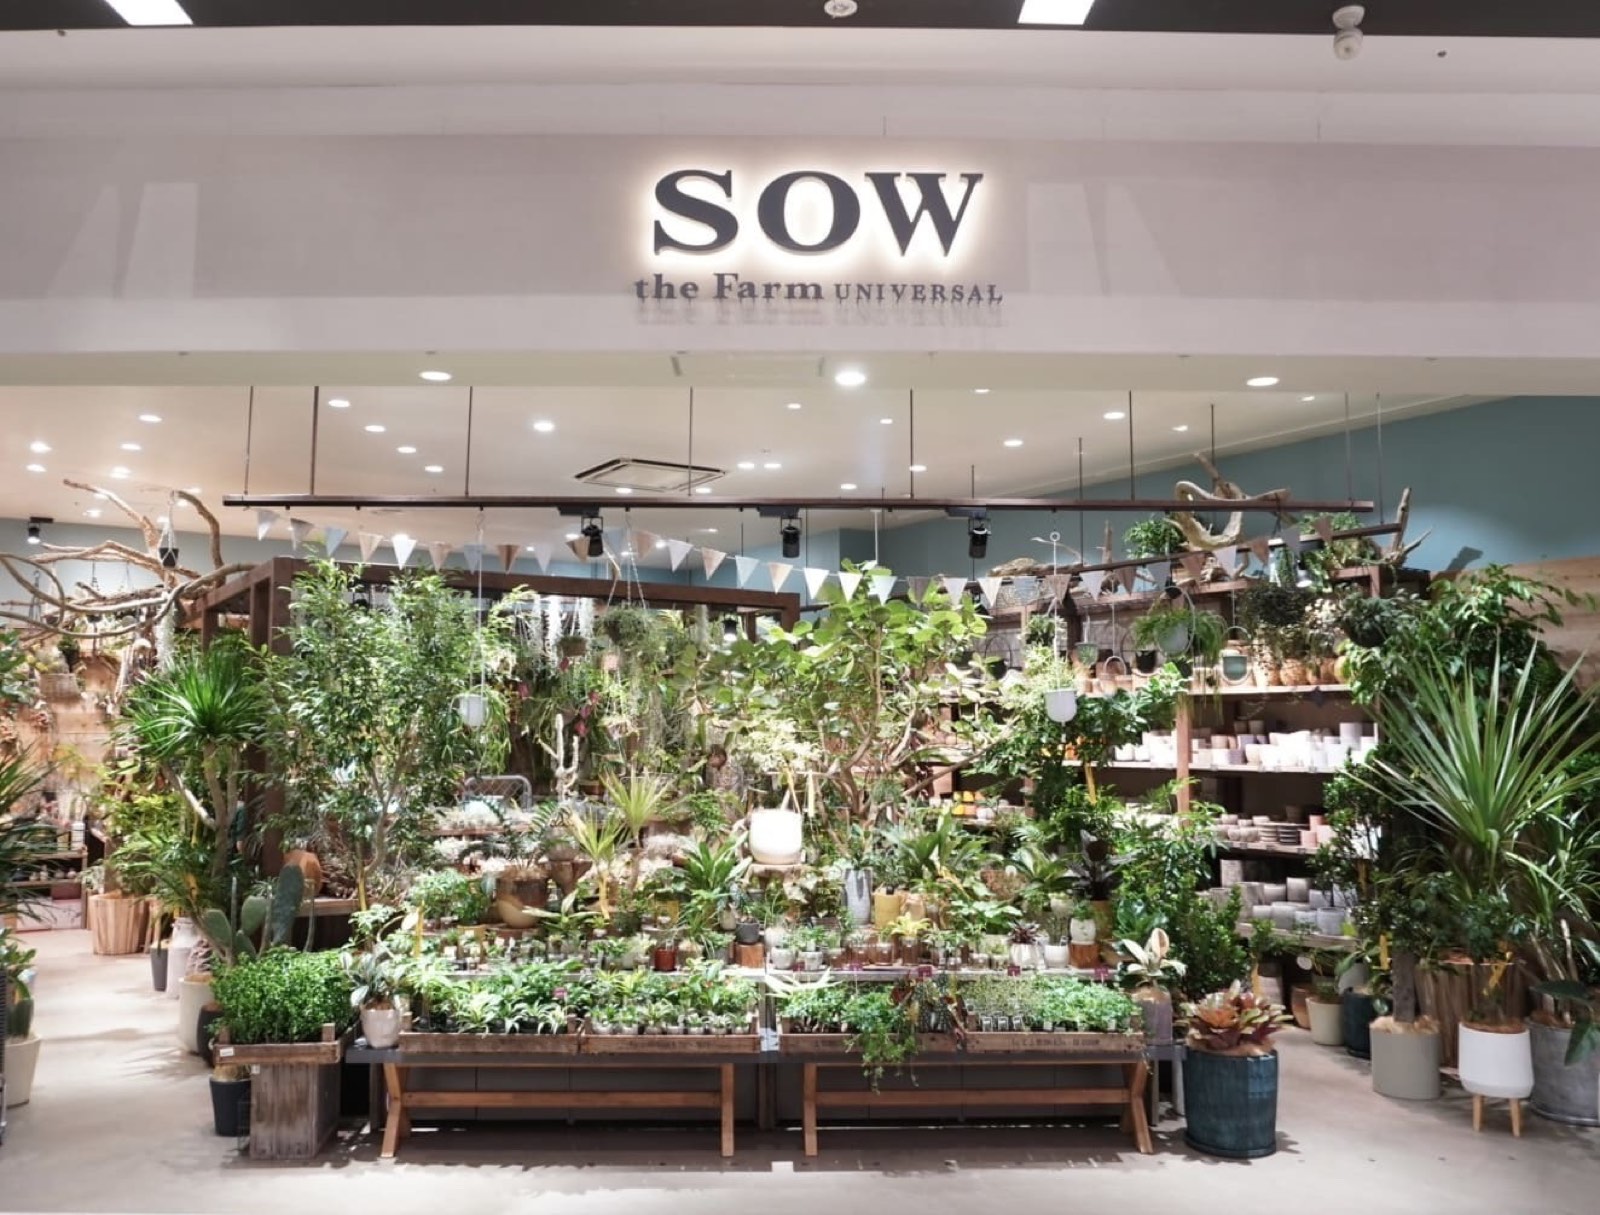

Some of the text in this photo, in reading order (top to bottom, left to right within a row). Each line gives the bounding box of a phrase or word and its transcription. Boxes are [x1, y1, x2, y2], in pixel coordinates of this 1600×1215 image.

[654, 169, 984, 256] SOW
[635, 273, 1003, 302] the Farm UNIVERSAL
